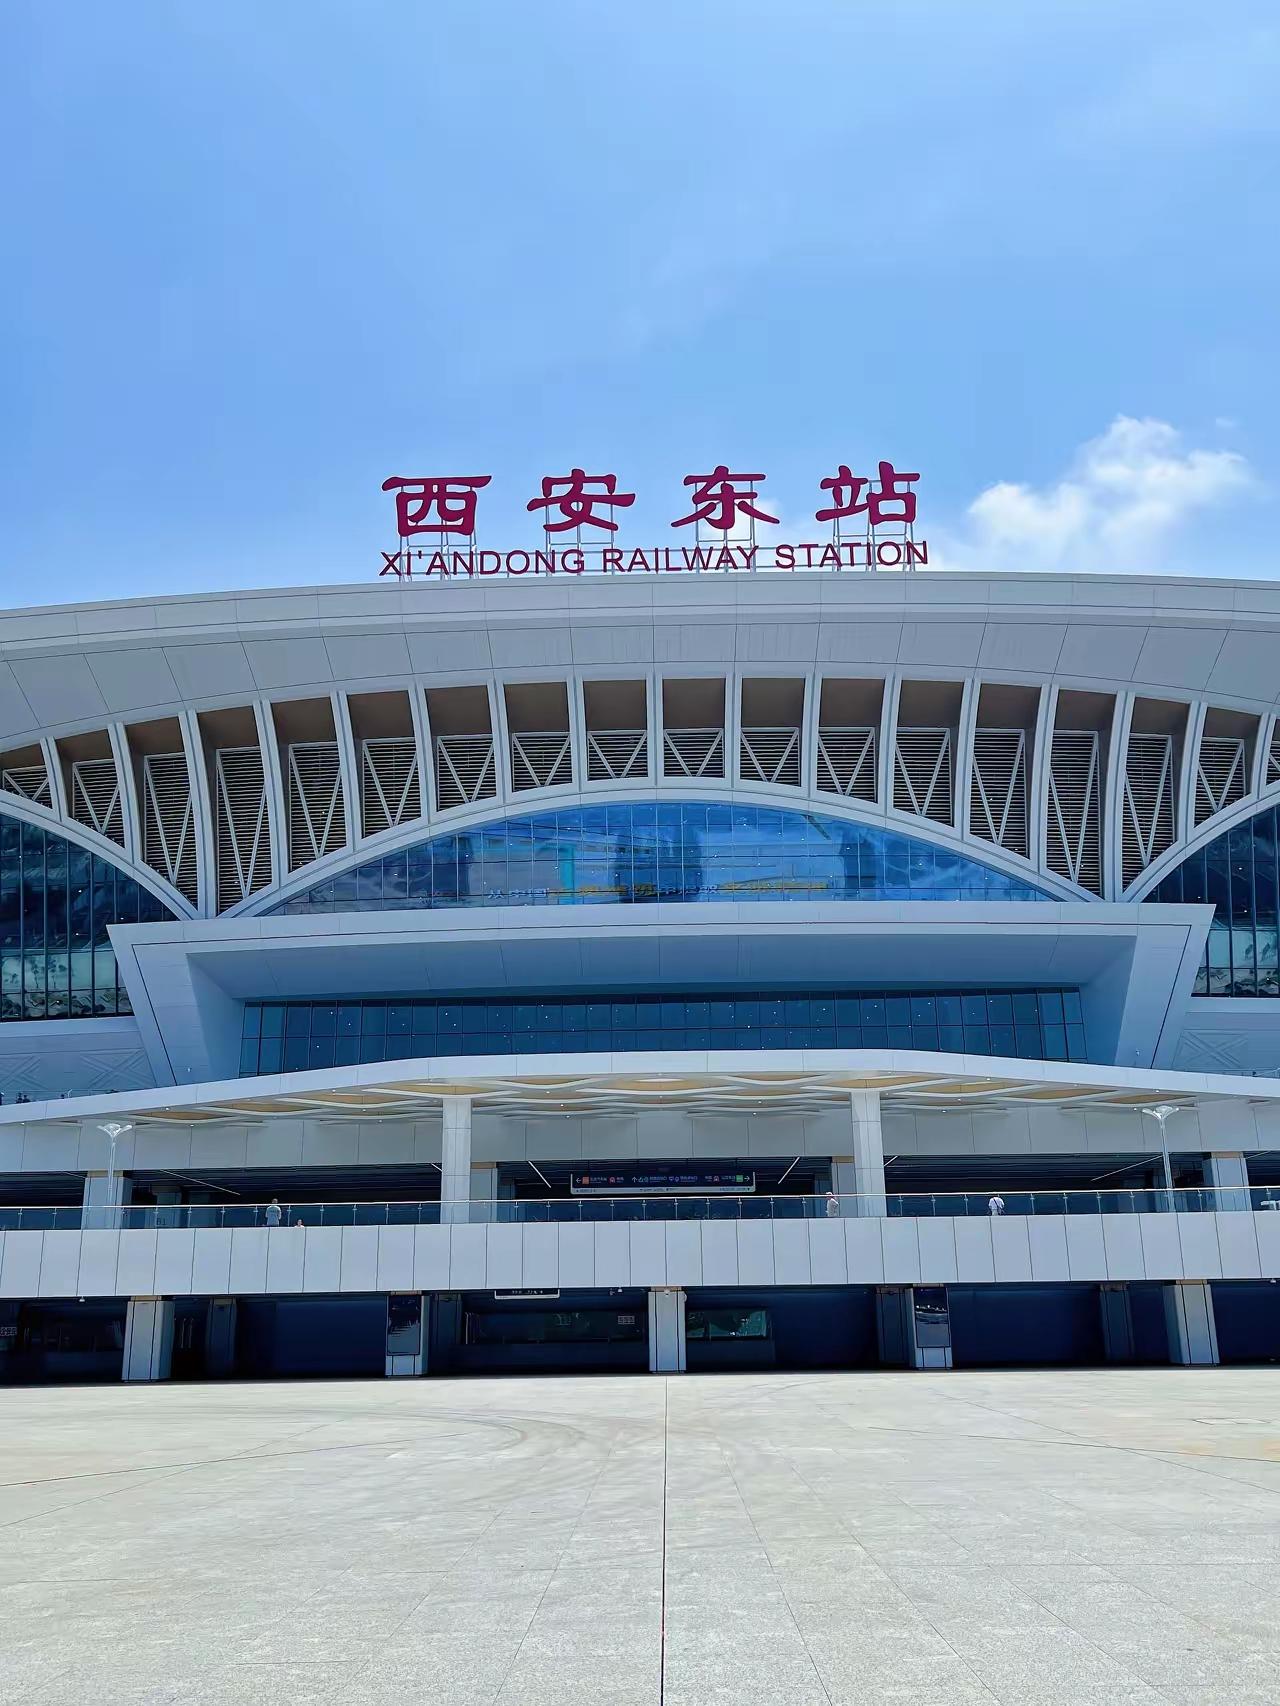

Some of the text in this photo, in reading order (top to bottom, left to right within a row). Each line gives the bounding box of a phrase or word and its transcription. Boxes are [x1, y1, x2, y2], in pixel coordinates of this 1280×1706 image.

[382, 461, 920, 537] 西安东站
[379, 540, 928, 577] XI'ANDONG RAILWAY STATION
